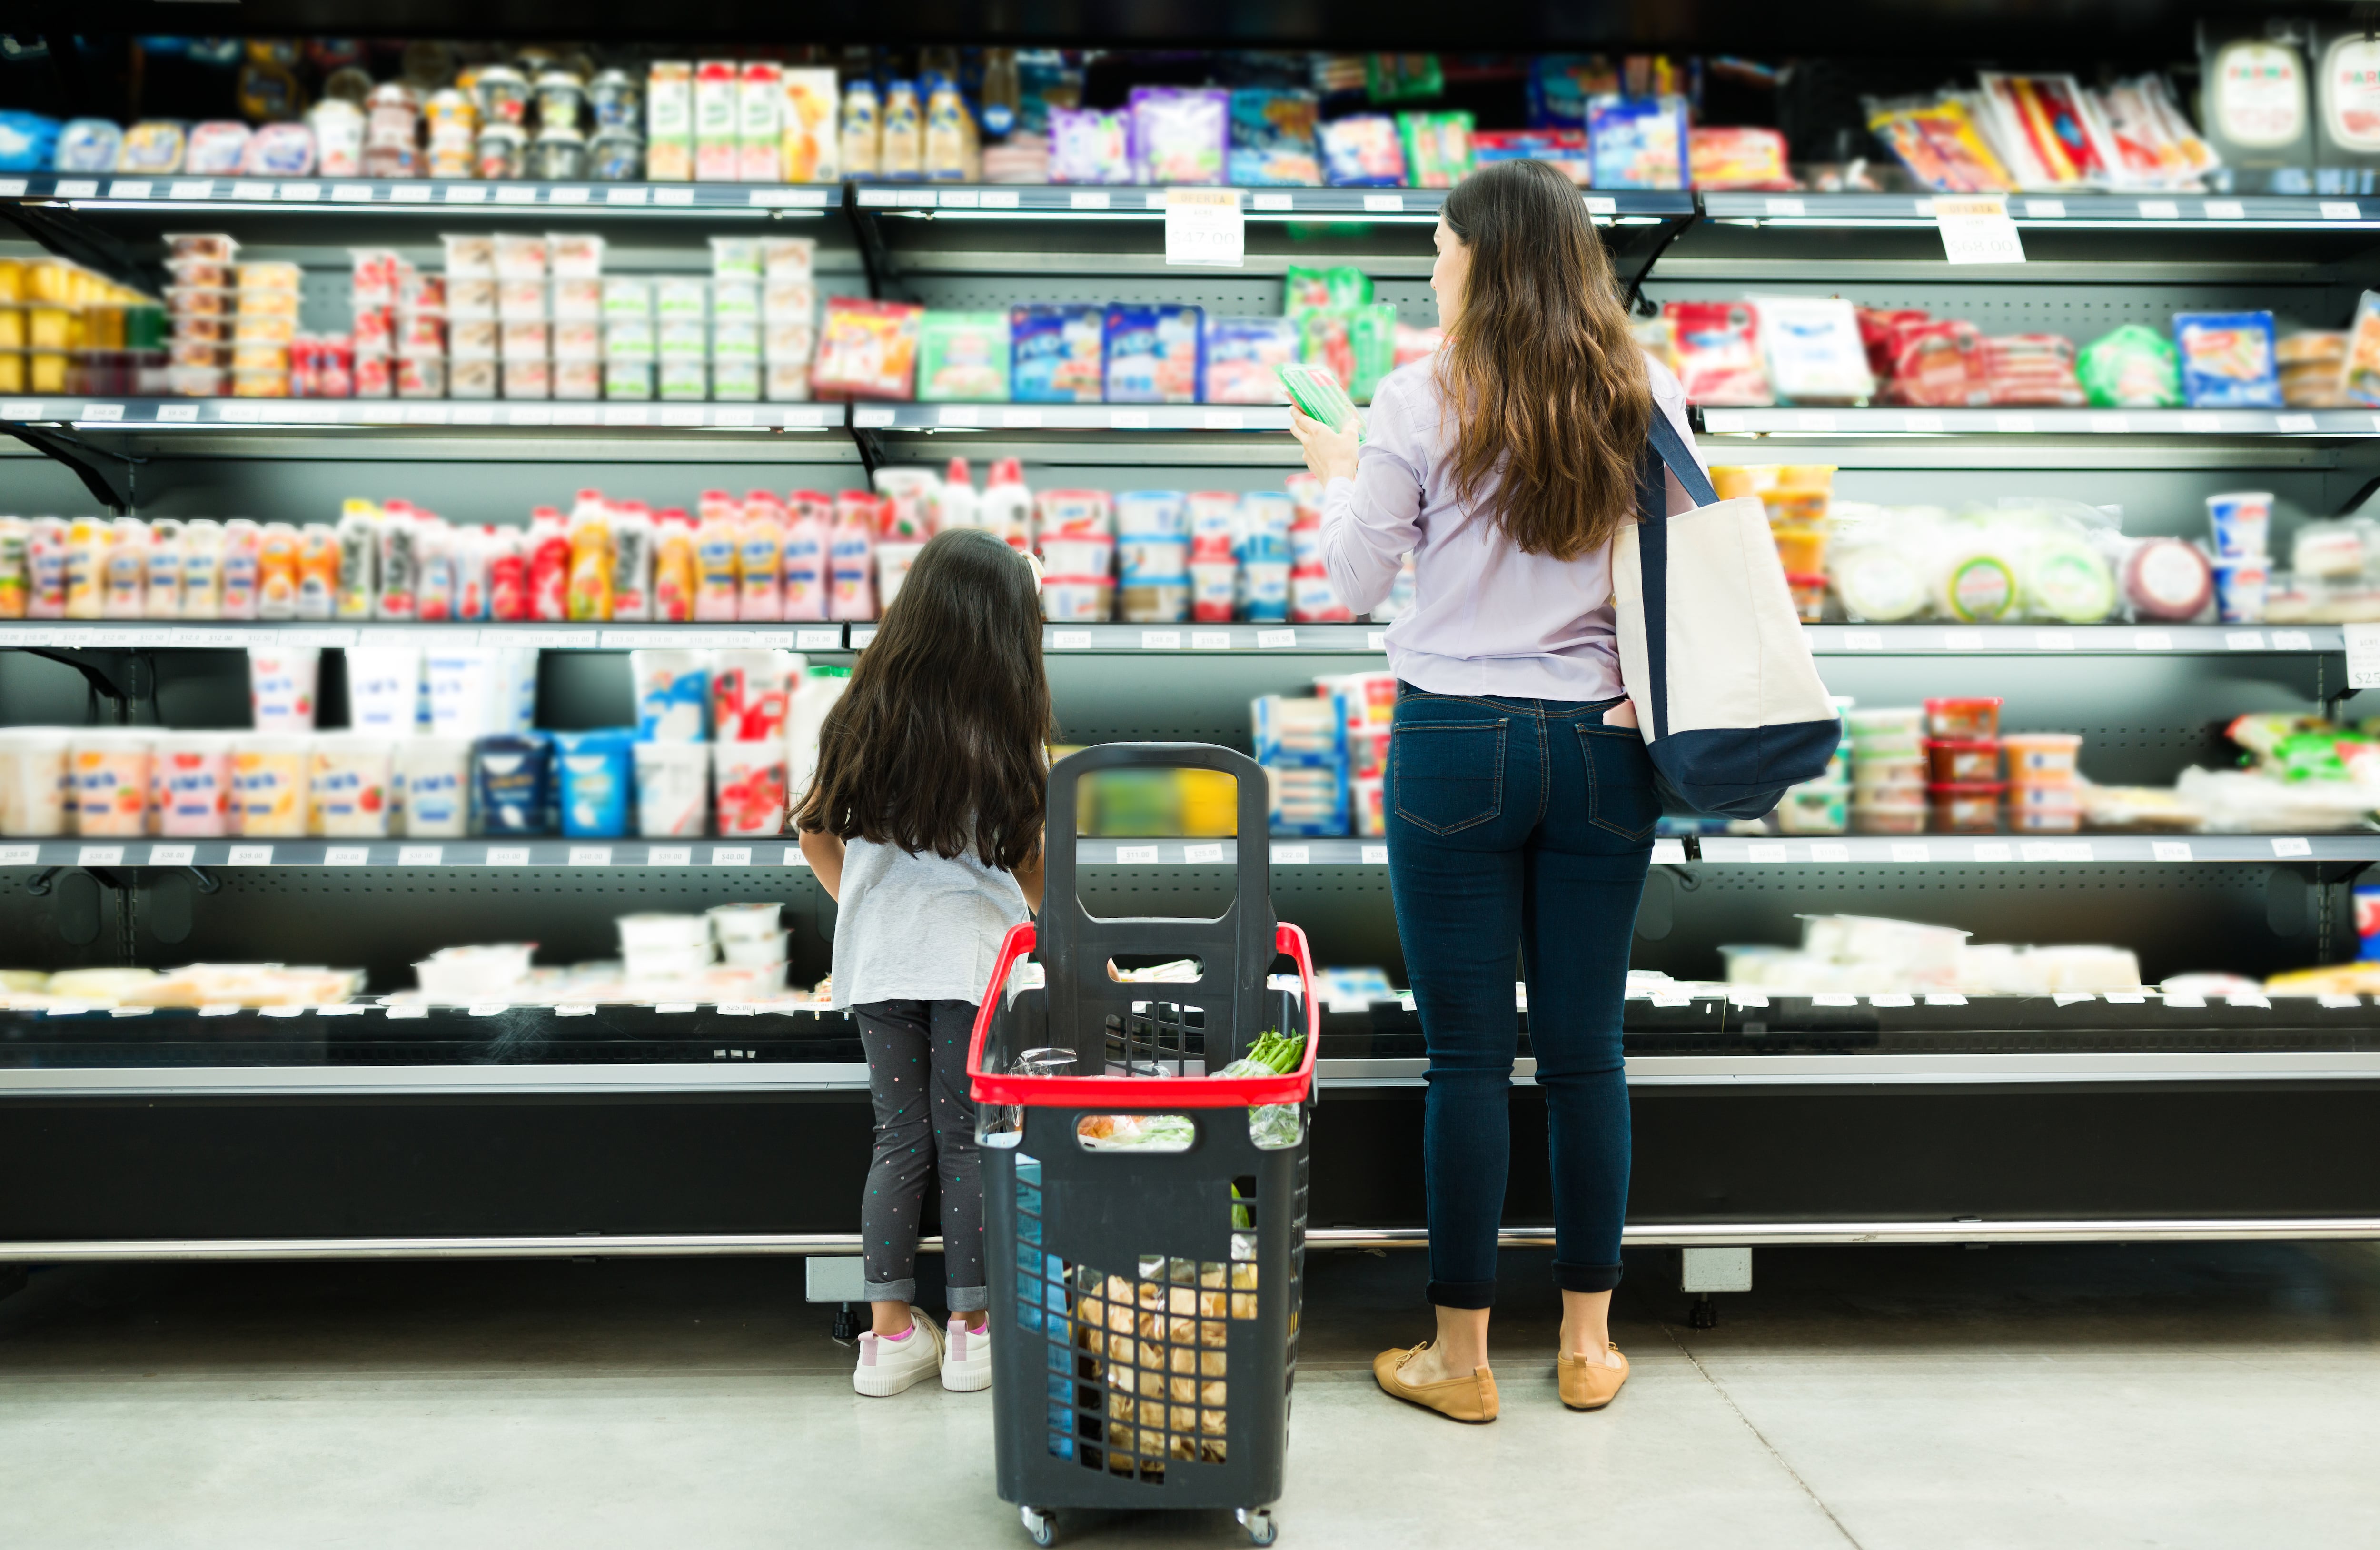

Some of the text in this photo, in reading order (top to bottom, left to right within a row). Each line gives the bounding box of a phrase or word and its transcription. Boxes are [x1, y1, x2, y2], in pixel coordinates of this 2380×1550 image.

[2229, 66, 2291, 80] PARMA
[2342, 70, 2380, 85] PAR
[1180, 194, 1226, 204] OFERTA
[1949, 205, 1994, 213] OFERTA
[1171, 229, 1235, 244] $47.00
[1950, 239, 2013, 254] $68.00
[1194, 849, 1217, 857] $25.00
